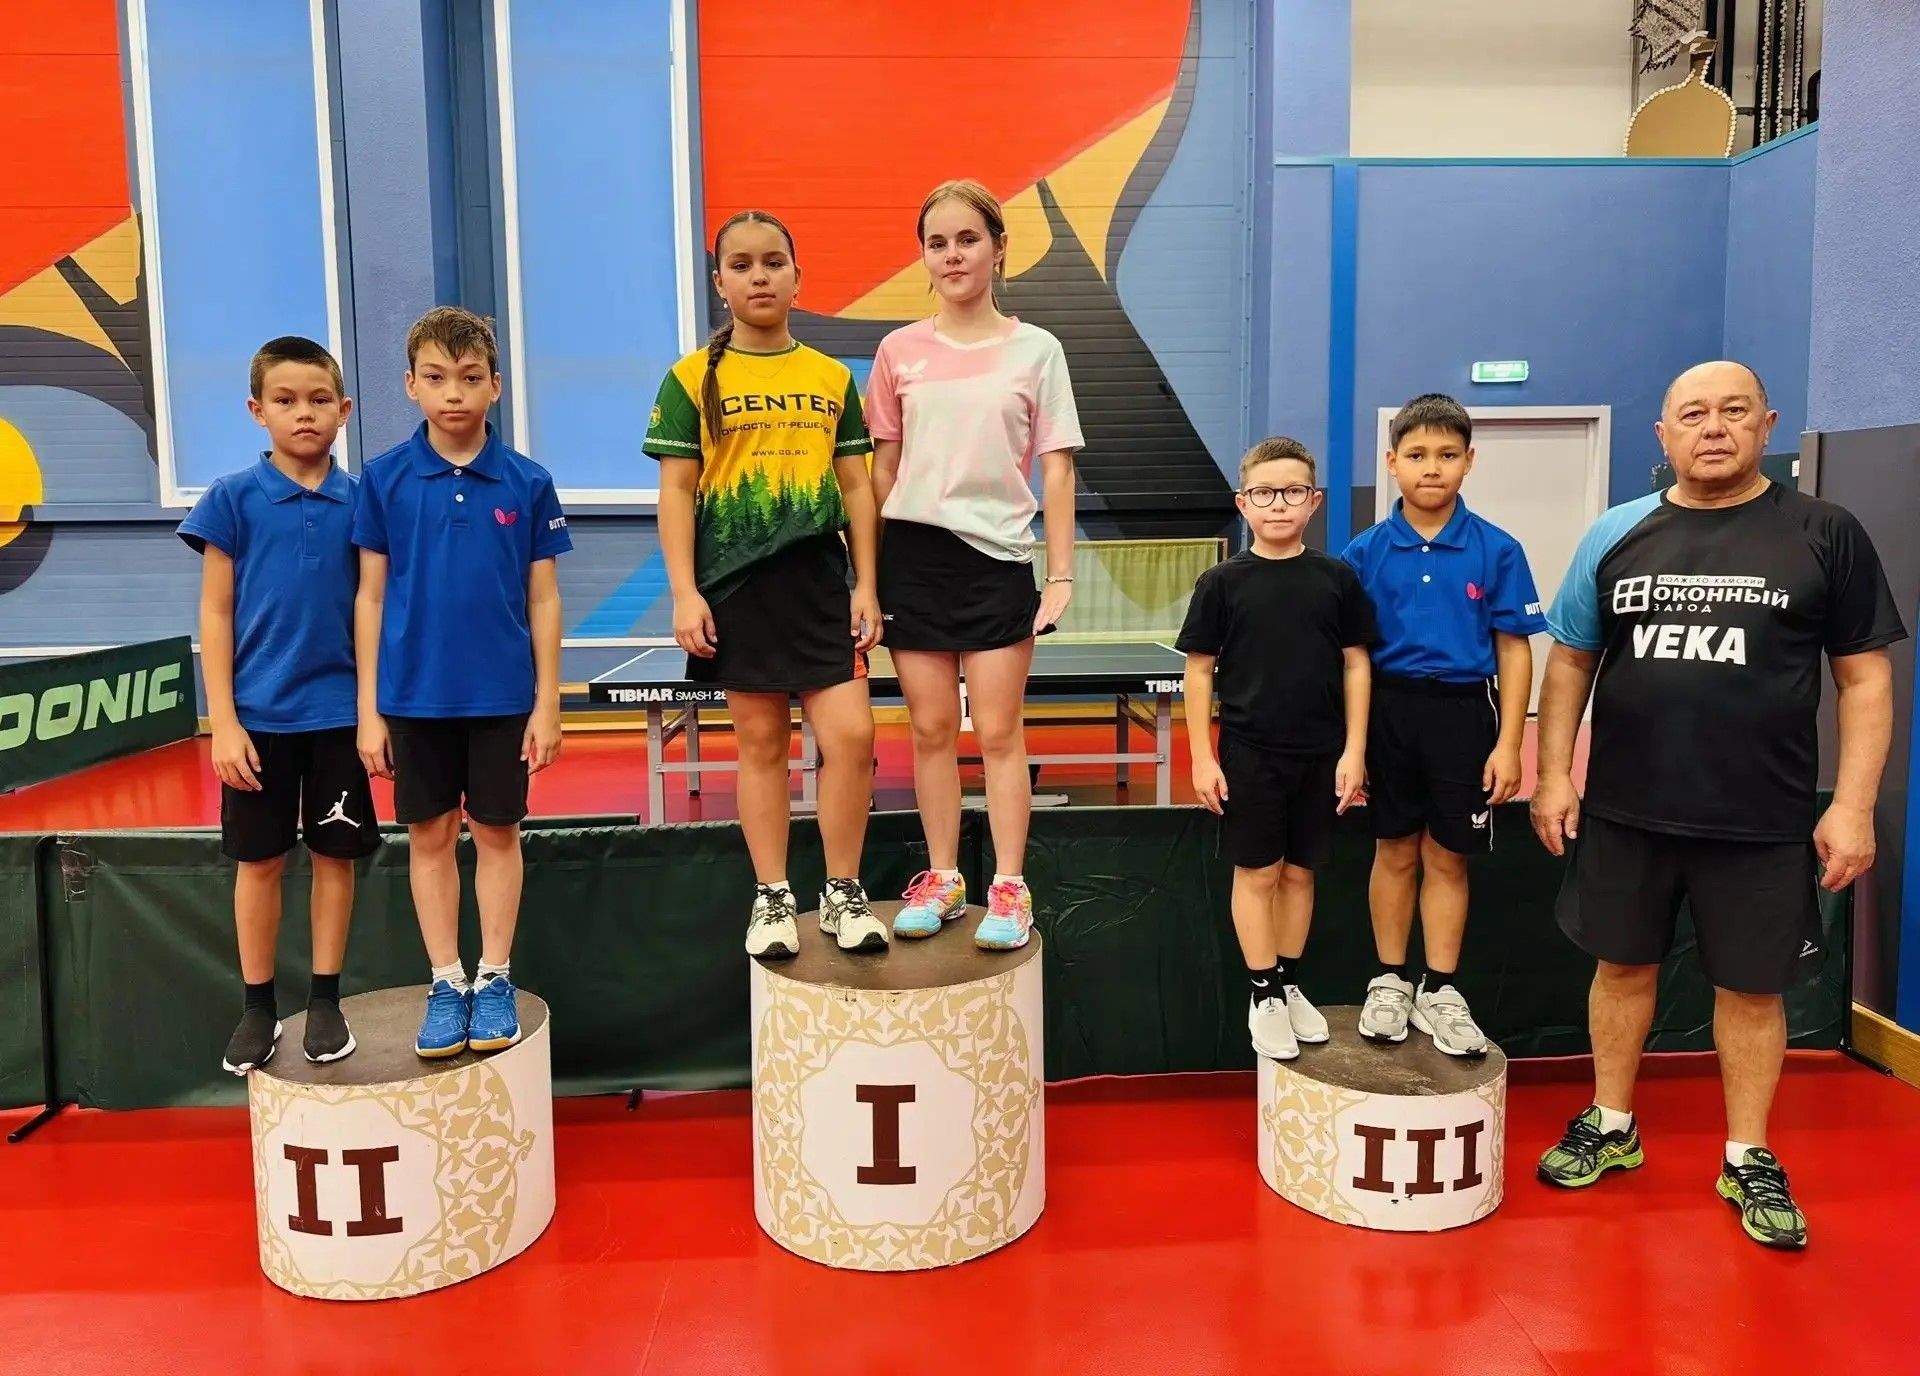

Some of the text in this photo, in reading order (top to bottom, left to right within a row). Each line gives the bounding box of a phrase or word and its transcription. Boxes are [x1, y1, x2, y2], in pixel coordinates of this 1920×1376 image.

[720, 393, 837, 418] CENTER
[721, 421, 771, 436] ОЧНОСТЬ
[1652, 586, 1790, 609] ОКОННЫЙ
[1653, 603, 1712, 613] ЗАВОД
[1632, 624, 1746, 665] VEKA
[607, 688, 673, 702] TIBHAR
[675, 690, 712, 701] SMASH
[1145, 679, 1185, 693] TIBH
[0, 662, 181, 751] DONIC
[856, 1084, 916, 1185] I
[1353, 1119, 1484, 1195] III
[283, 1143, 403, 1237] II
